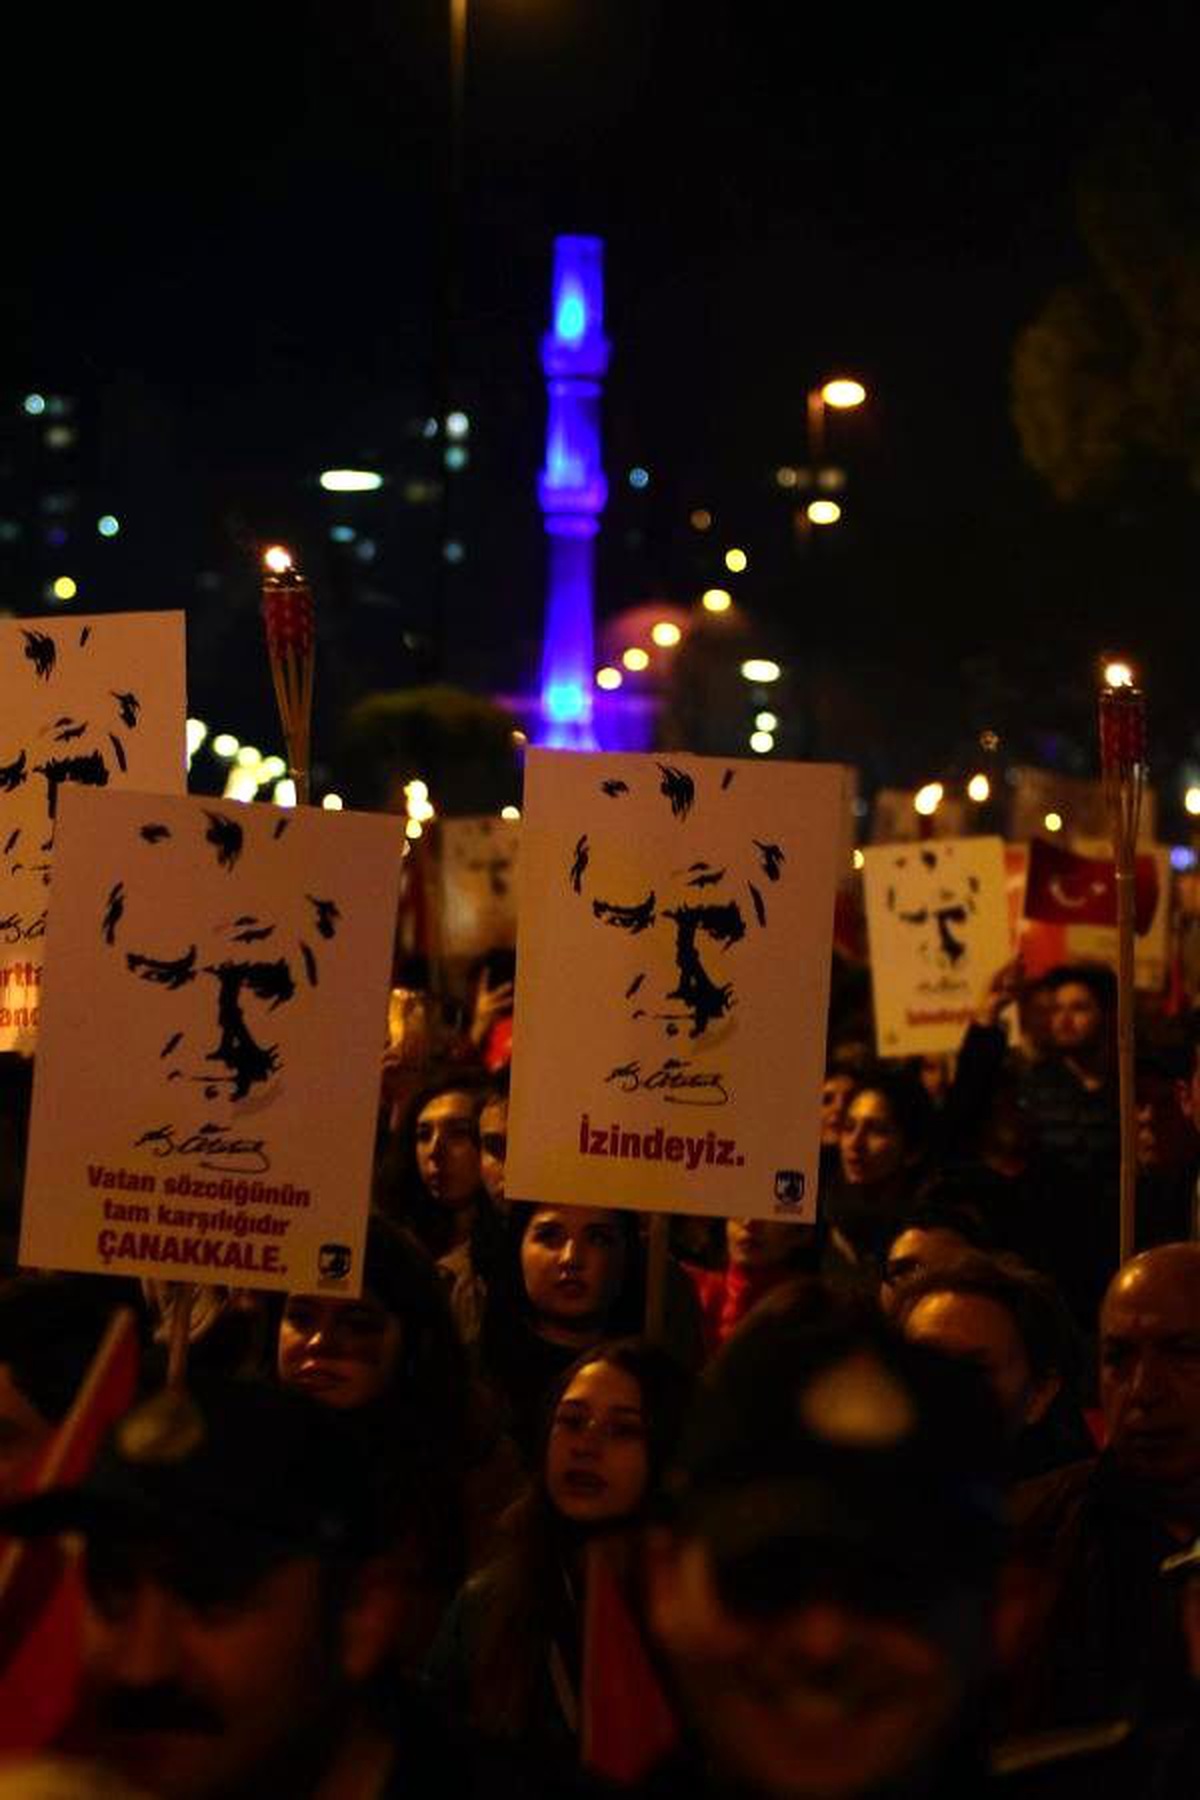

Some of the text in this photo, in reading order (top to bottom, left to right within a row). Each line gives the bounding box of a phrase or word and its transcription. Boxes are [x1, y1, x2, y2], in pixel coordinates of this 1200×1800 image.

[579, 1114, 745, 1170] İzindeyiz.
[88, 1165, 310, 1207] Vatan sözcüğünün
[103, 1198, 290, 1237] tam karşılığıdır
[98, 1230, 287, 1274] ÇANAKKALE.
